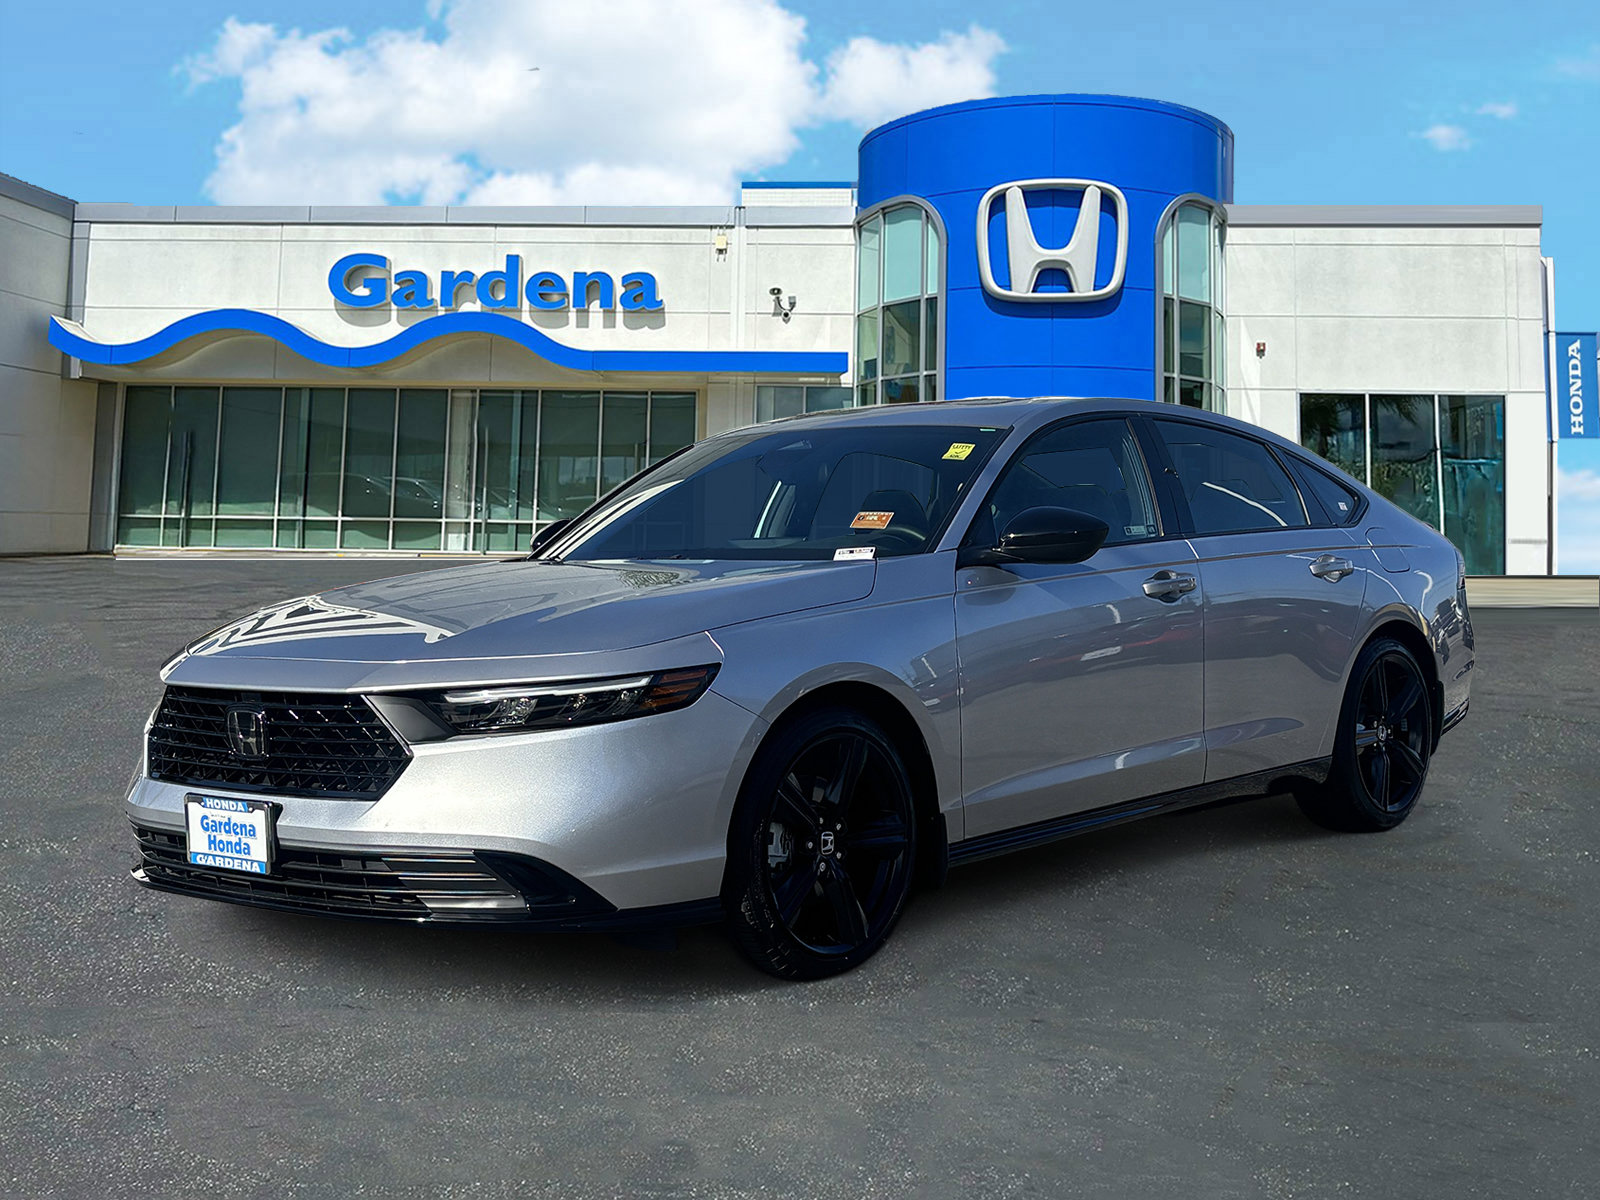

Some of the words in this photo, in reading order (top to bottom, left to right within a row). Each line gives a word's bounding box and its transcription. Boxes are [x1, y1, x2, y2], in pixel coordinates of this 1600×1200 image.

[328, 253, 664, 309] Gardena
[1568, 339, 1584, 435] HONDA
[206, 798, 245, 812] HONDA
[200, 814, 256, 838] Gardena
[207, 834, 251, 855] Honda
[196, 854, 261, 872] GARDENA
